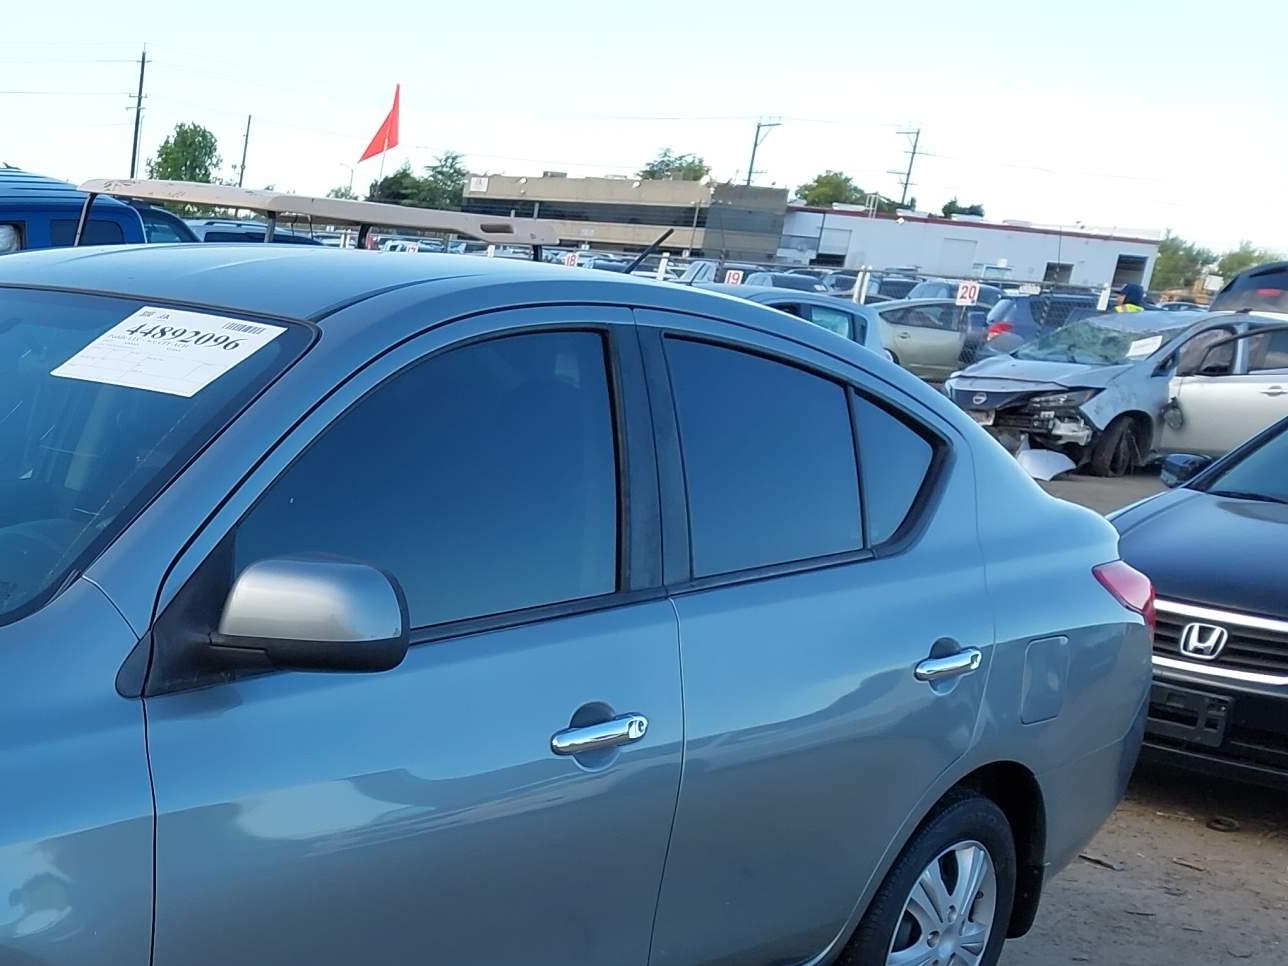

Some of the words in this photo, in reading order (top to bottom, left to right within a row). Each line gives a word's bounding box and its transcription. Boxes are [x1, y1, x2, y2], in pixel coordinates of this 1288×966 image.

[566, 254, 577, 267] 18
[726, 271, 741, 285] 19
[959, 284, 977, 300] 20
[125, 322, 249, 352] 44892096
